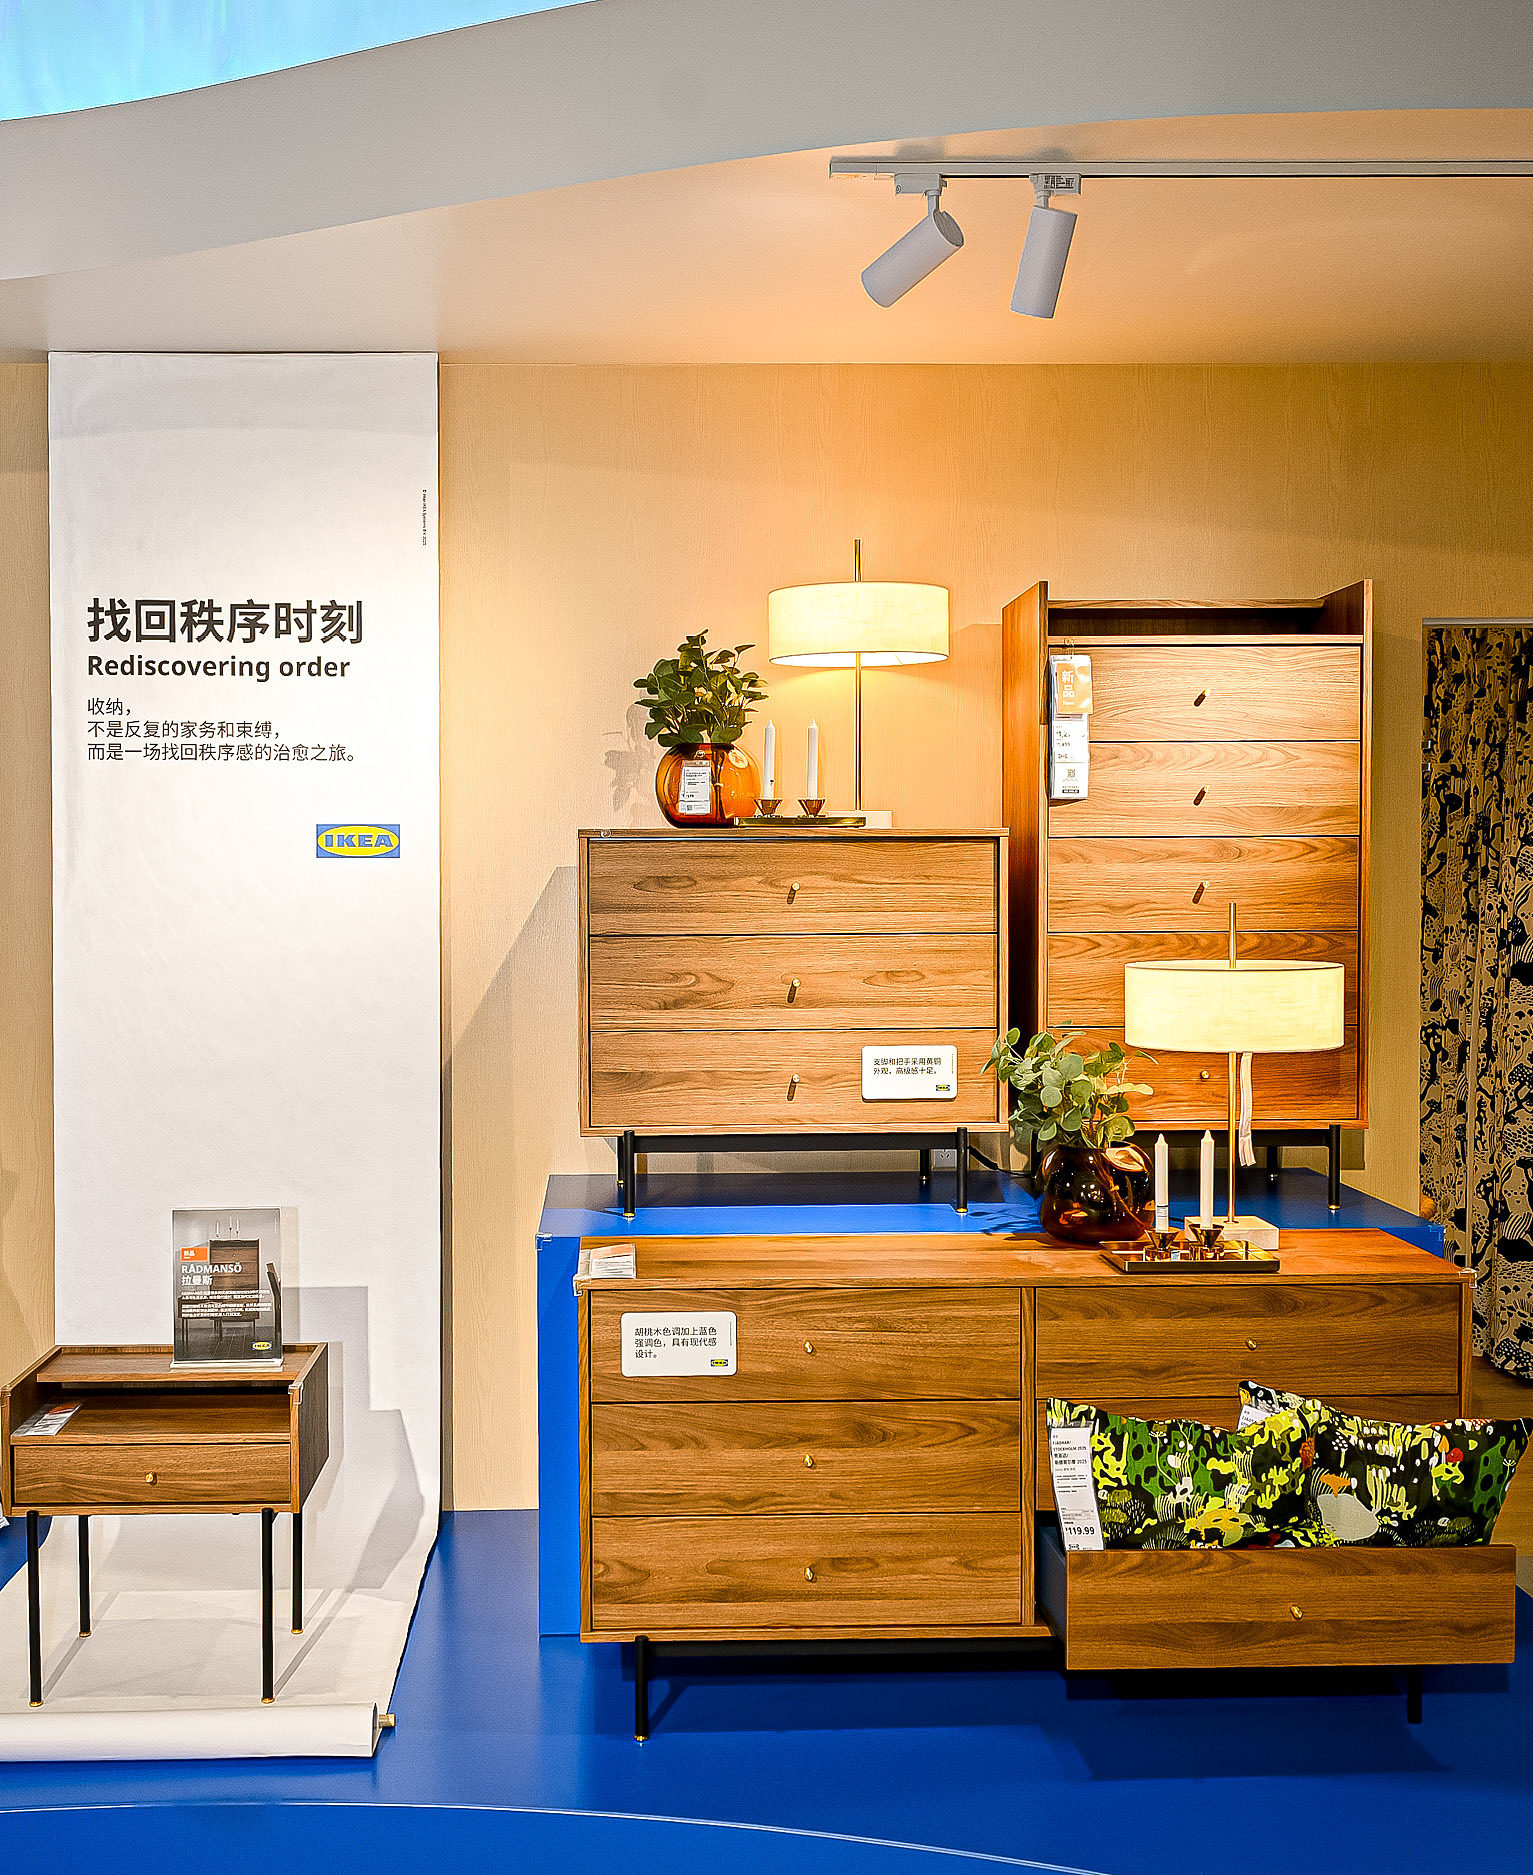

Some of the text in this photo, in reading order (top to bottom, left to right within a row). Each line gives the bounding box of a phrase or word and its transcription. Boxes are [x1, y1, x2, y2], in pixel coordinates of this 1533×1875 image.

[87, 598, 363, 644] 找回秩序时刻
[88, 655, 351, 682] Rediscovering order
[1061, 670, 1075, 698] 新品
[88, 697, 132, 716] 收纳，
[88, 720, 281, 740] 不是反复的家务和束缚，
[87, 743, 356, 762] 而是一场找回秩序感的治愈之旅。
[324, 834, 394, 848] IKEA
[181, 1262, 243, 1274] RÅDMANSÖ
[634, 1326, 718, 1337] 胡桃木色调加上蓝色
[634, 1337, 718, 1347] 强调色，具有现代感
[635, 1349, 658, 1359] 设计。
